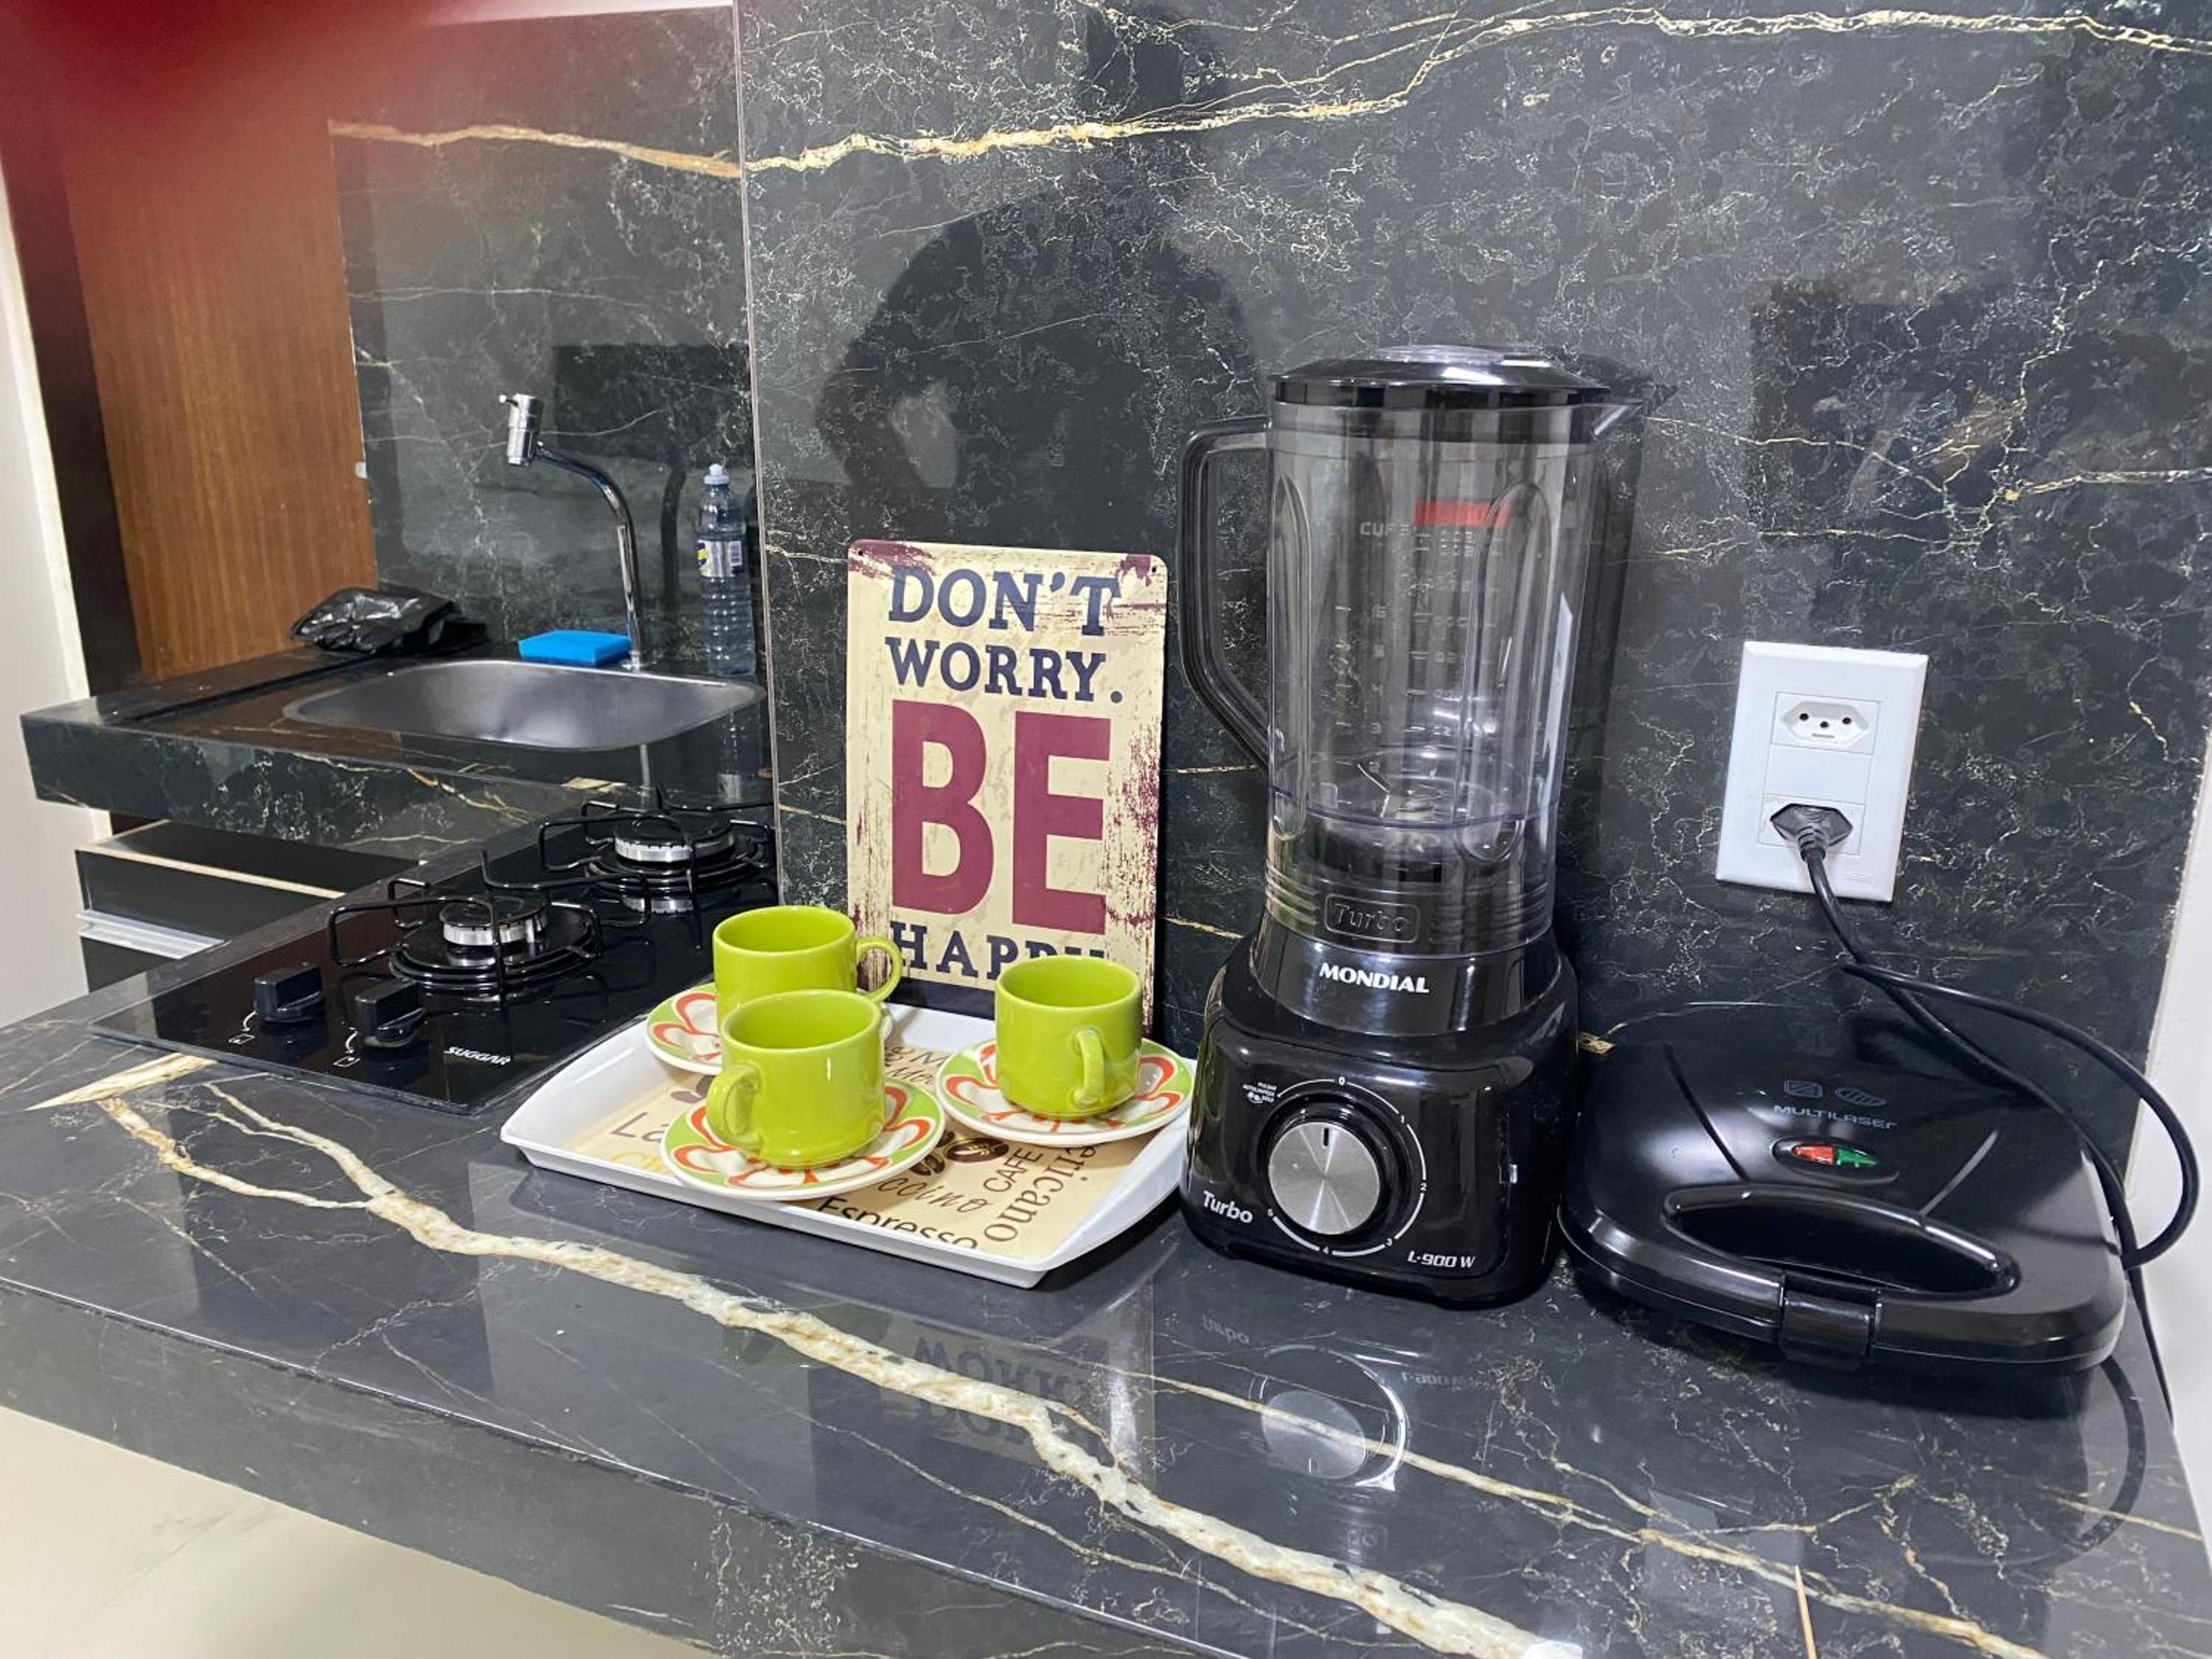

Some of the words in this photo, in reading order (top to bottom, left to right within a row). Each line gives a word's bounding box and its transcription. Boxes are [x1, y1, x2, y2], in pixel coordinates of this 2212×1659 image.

[888, 565, 1121, 637] DON'T
[884, 636, 1124, 704] WORRY.
[891, 699, 1111, 936] BE
[1334, 903, 1411, 932] Turbo
[889, 919, 1106, 981] HAP
[1318, 962, 1430, 994] MONDIAL
[983, 1147, 1044, 1192] CAFE
[1419, 1182, 1427, 1192] 2
[877, 1178, 994, 1213] ccino
[984, 1145, 1096, 1242] ericano
[1203, 1189, 1253, 1224] Turbo
[1322, 1246, 1329, 1255] 4
[1385, 1237, 1393, 1247] 3
[1459, 1255, 1475, 1269] W
